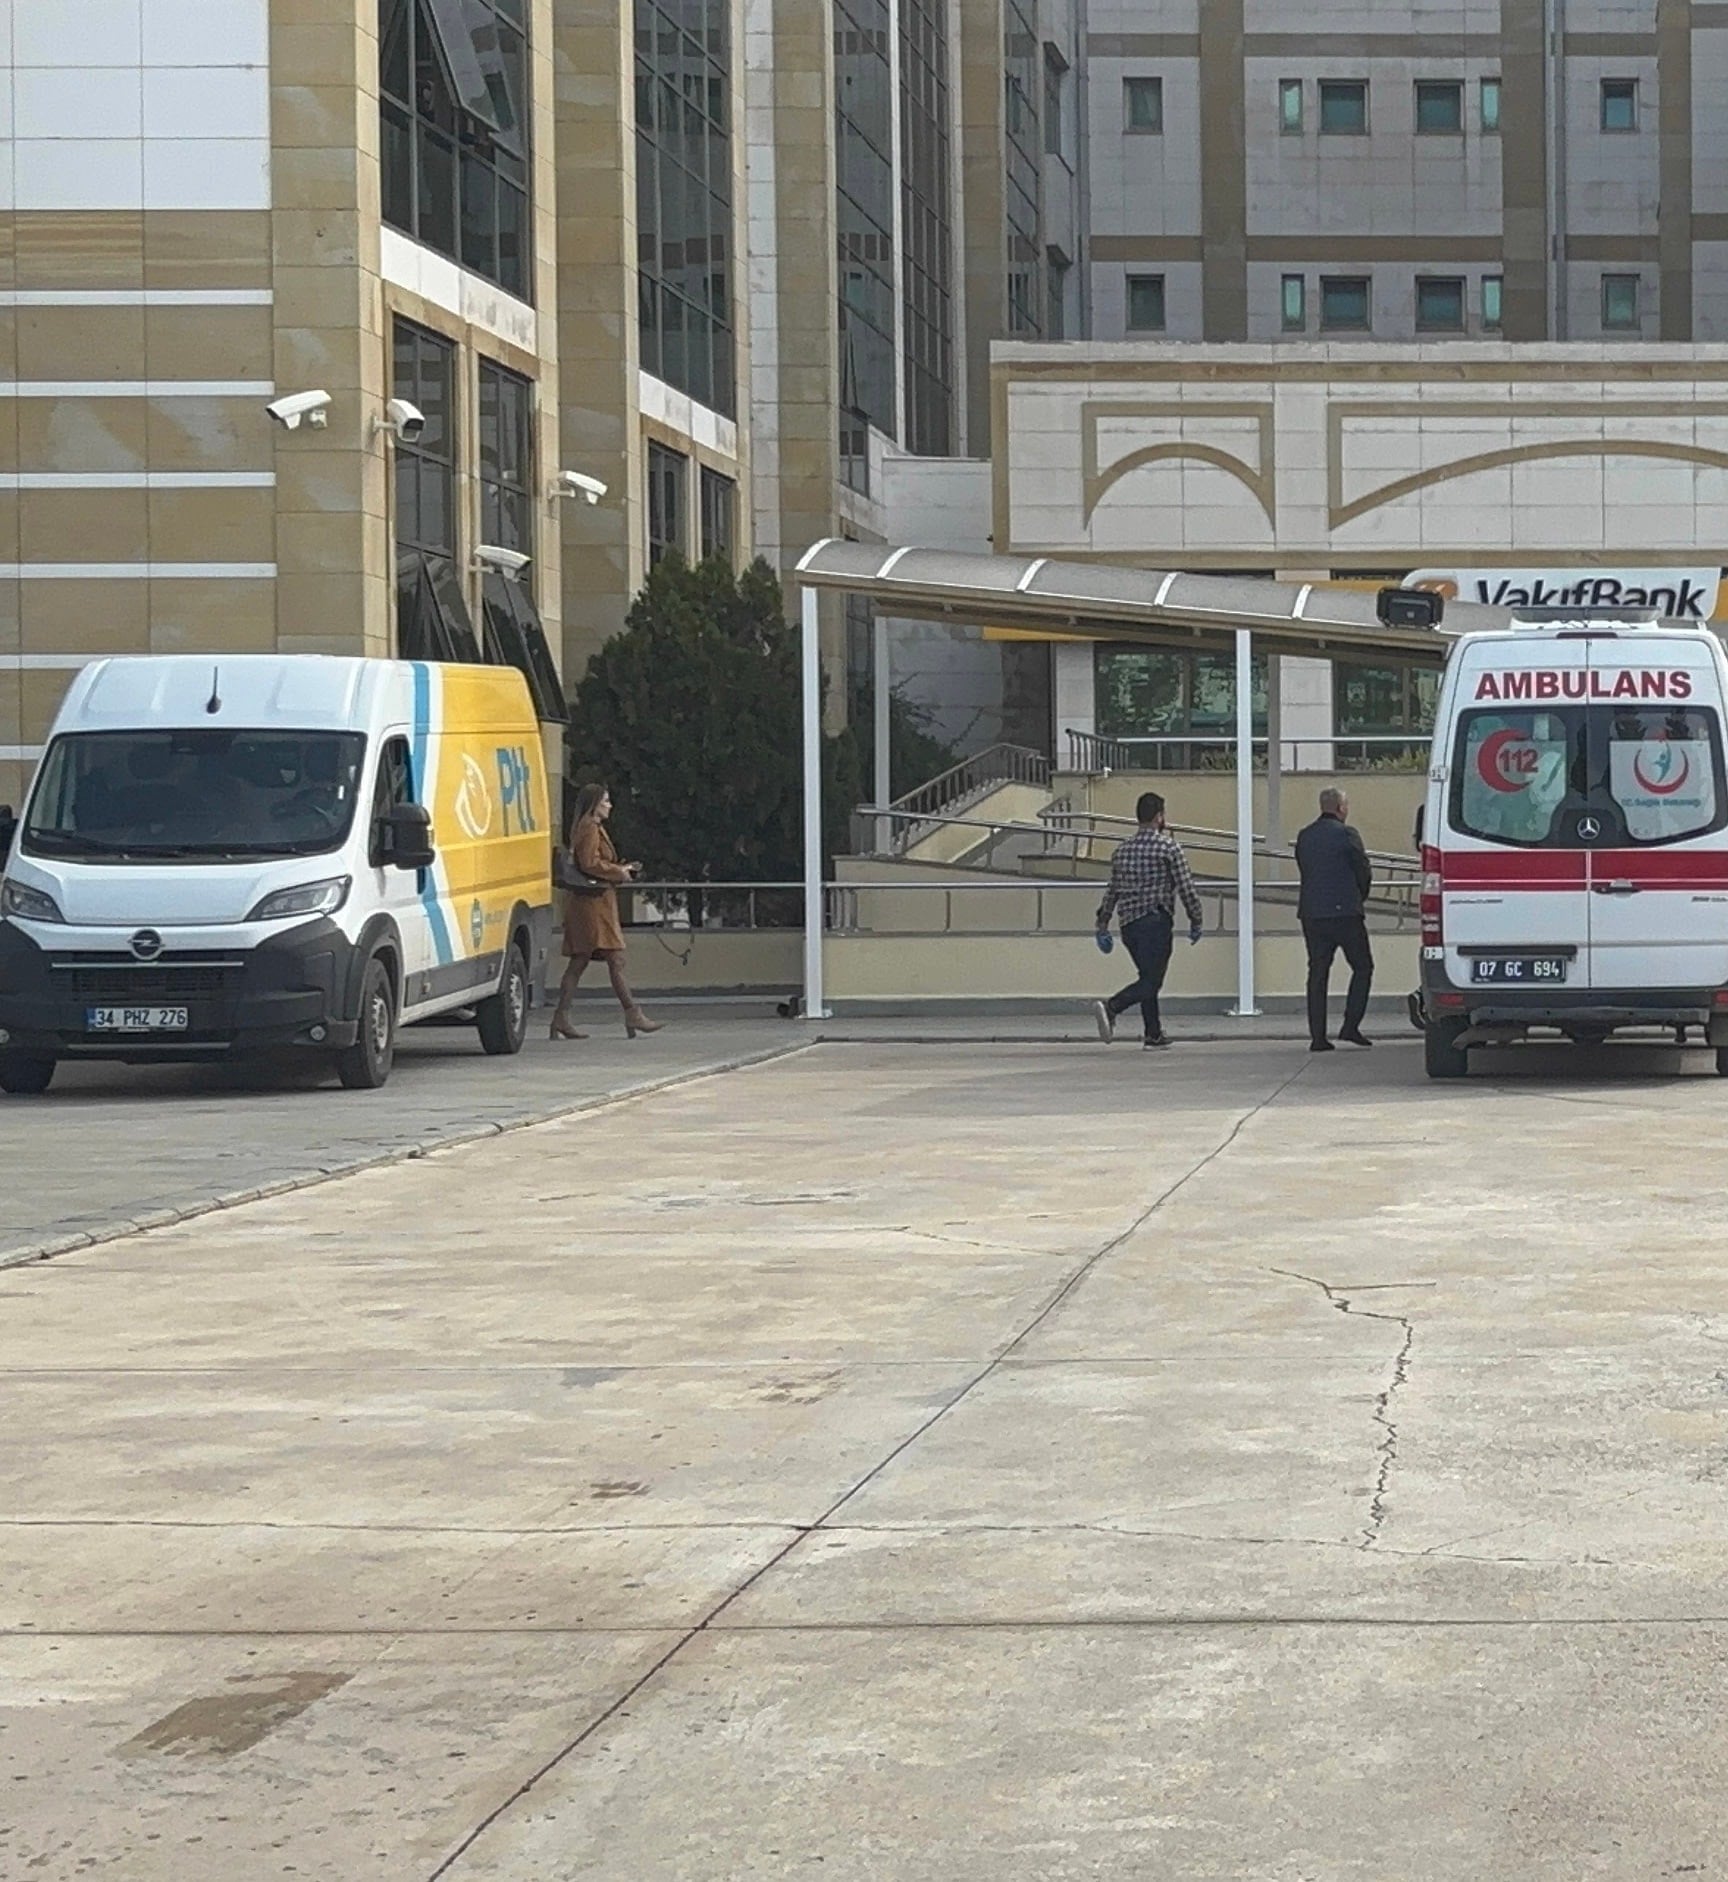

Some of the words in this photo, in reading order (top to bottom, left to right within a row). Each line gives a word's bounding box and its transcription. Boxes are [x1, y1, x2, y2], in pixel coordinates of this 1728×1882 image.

[1474, 670, 1693, 700] AMBULANS
[1499, 748, 1539, 774] 112
[1479, 961, 1497, 977] 07
[1504, 961, 1523, 977] GC
[1533, 961, 1560, 977] 694
[97, 1009, 115, 1026] 34
[123, 1009, 151, 1026] PHZ
[159, 1009, 187, 1025] 276
